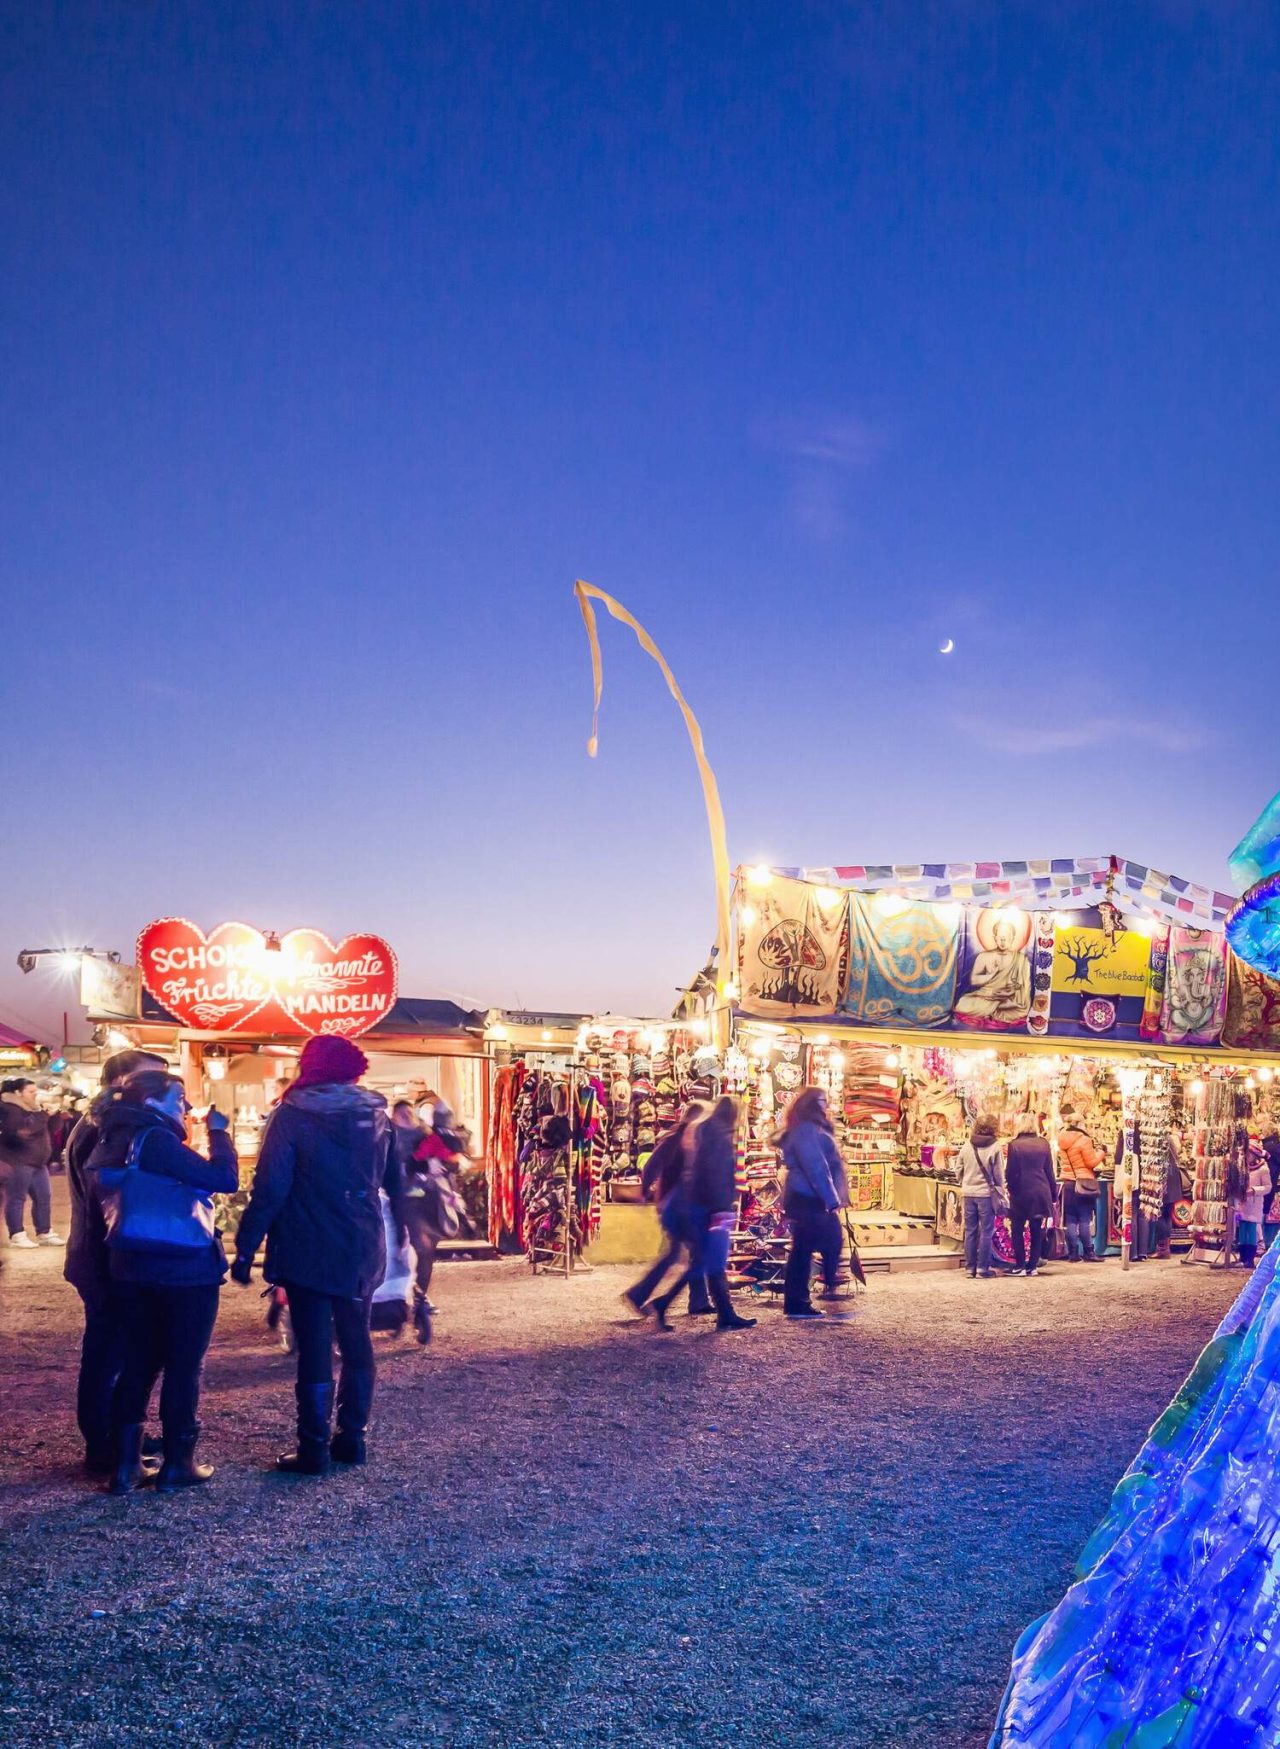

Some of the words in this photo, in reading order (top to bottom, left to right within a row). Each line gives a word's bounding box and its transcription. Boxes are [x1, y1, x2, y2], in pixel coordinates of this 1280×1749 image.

[151, 944, 257, 974] SCHOK
[1094, 968, 1108, 979] The
[1122, 970, 1145, 982] Baobab
[162, 971, 266, 1005] Früchte
[286, 993, 387, 1014] MANDELN
